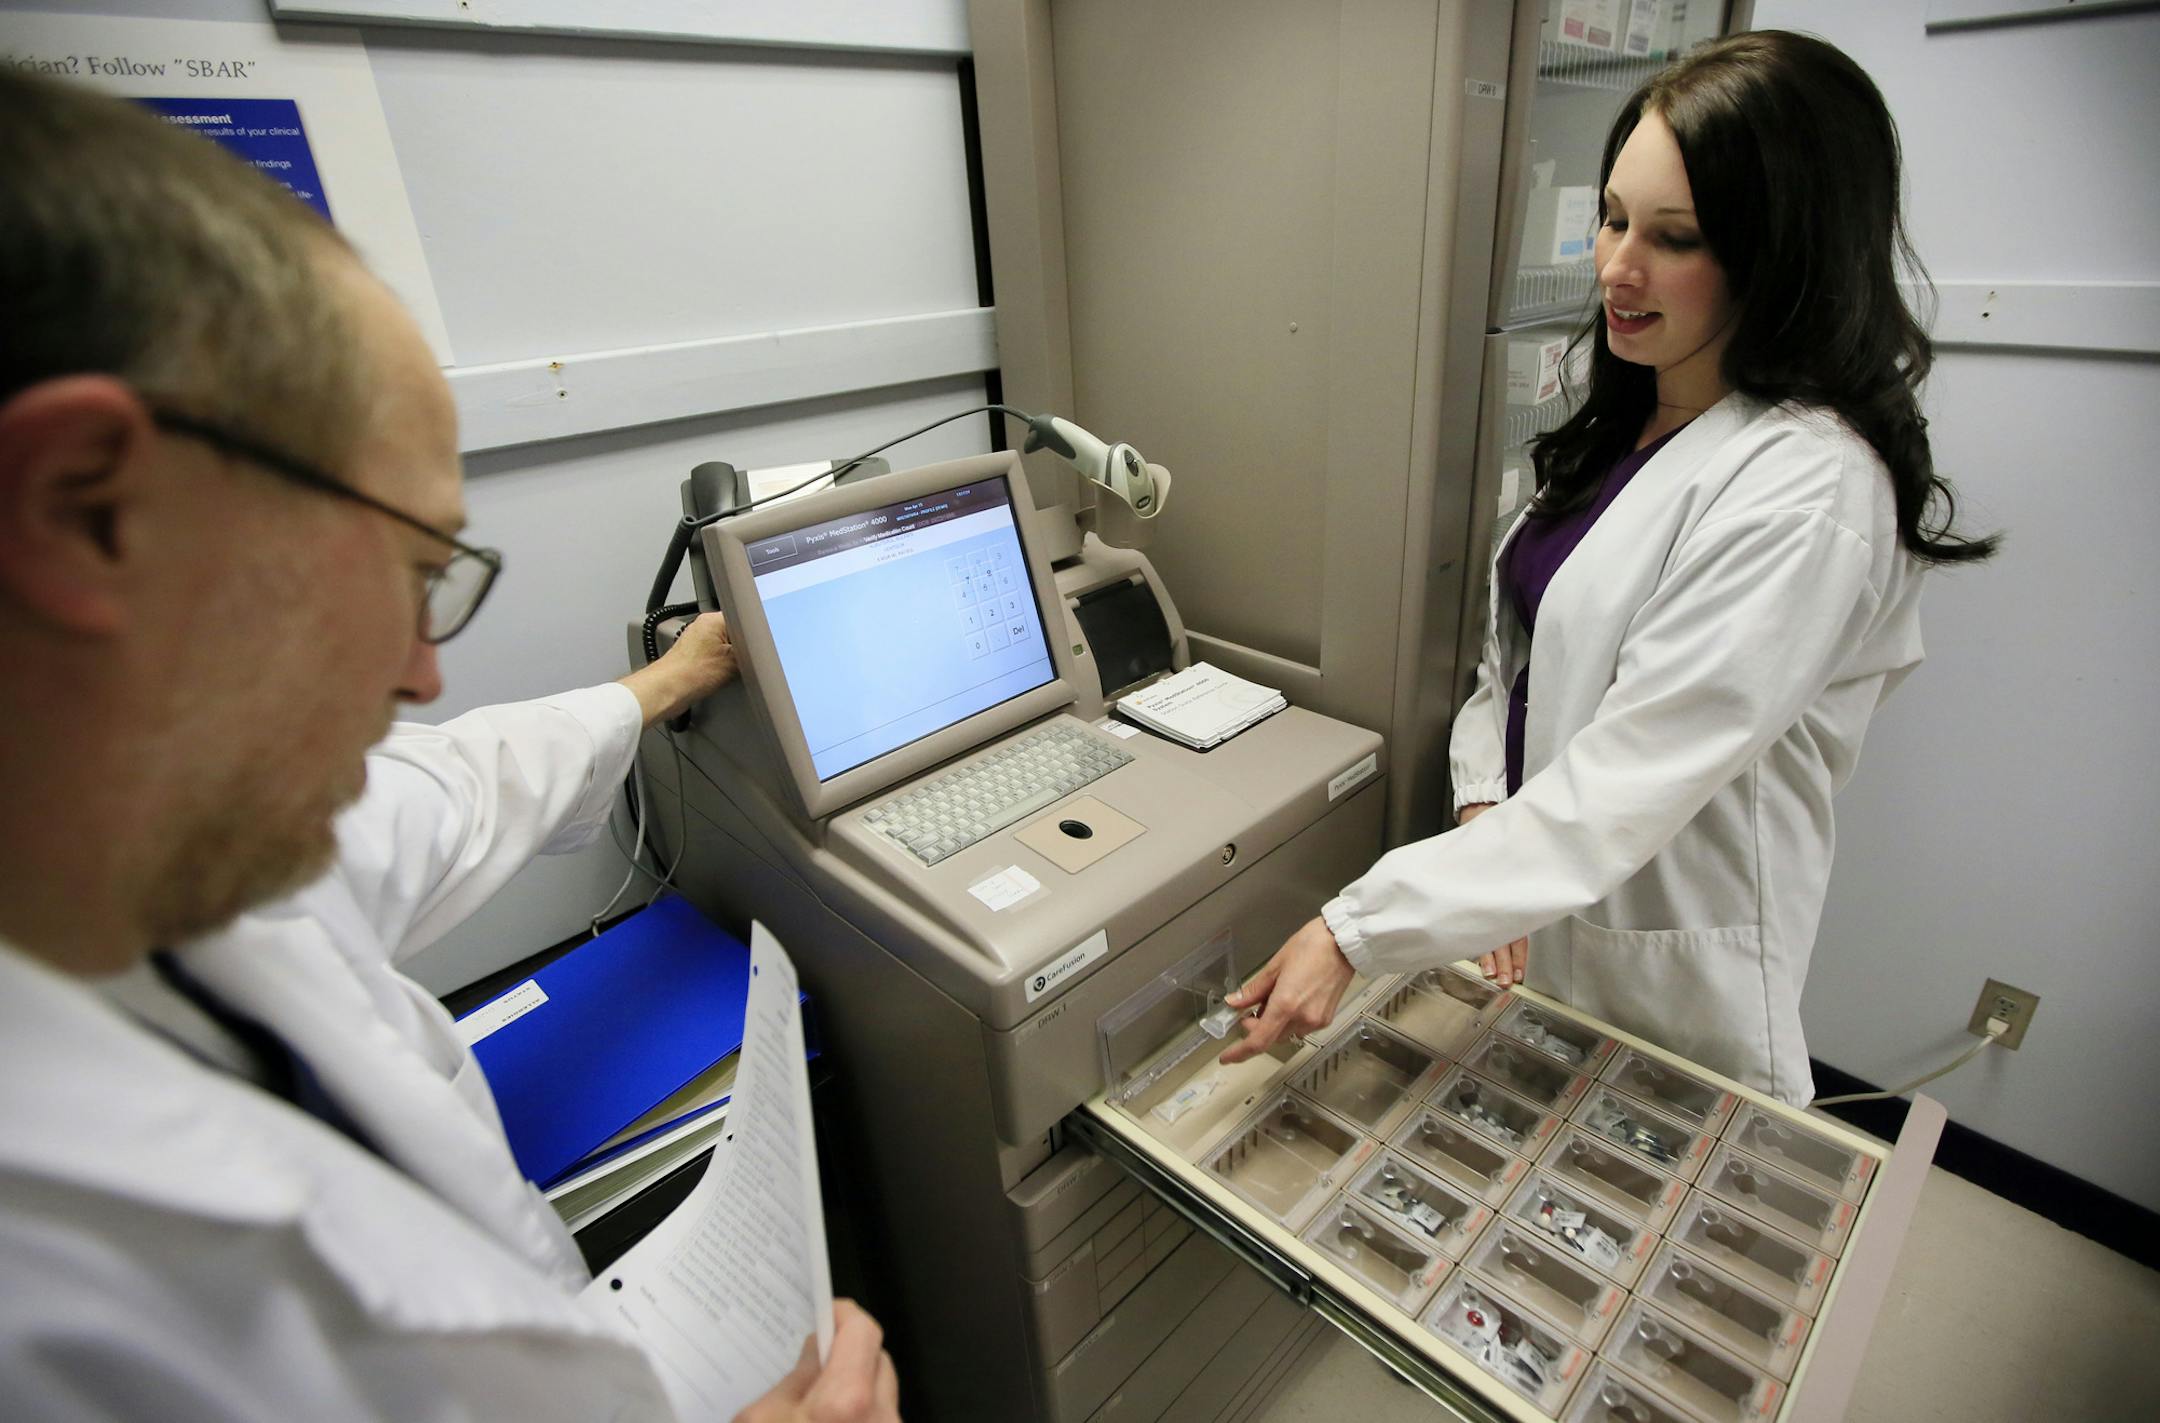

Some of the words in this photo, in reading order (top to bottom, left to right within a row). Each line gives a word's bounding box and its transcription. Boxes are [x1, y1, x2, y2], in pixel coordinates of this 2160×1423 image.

[7, 54, 79, 75] ician?
[86, 56, 165, 76] Follow
[174, 58, 255, 78] "SBAR"
[156, 114, 232, 125] ssessment
[203, 127, 235, 136] results
[237, 127, 246, 136] of
[247, 128, 266, 138] your
[269, 127, 300, 136] clinical
[255, 159, 292, 169] findings
[871, 516, 888, 526] 4000
[863, 534, 878, 543] Verify
[901, 523, 915, 532] Count
[1012, 624, 1025, 636] Del
[1046, 953, 1085, 981] CareFusion
